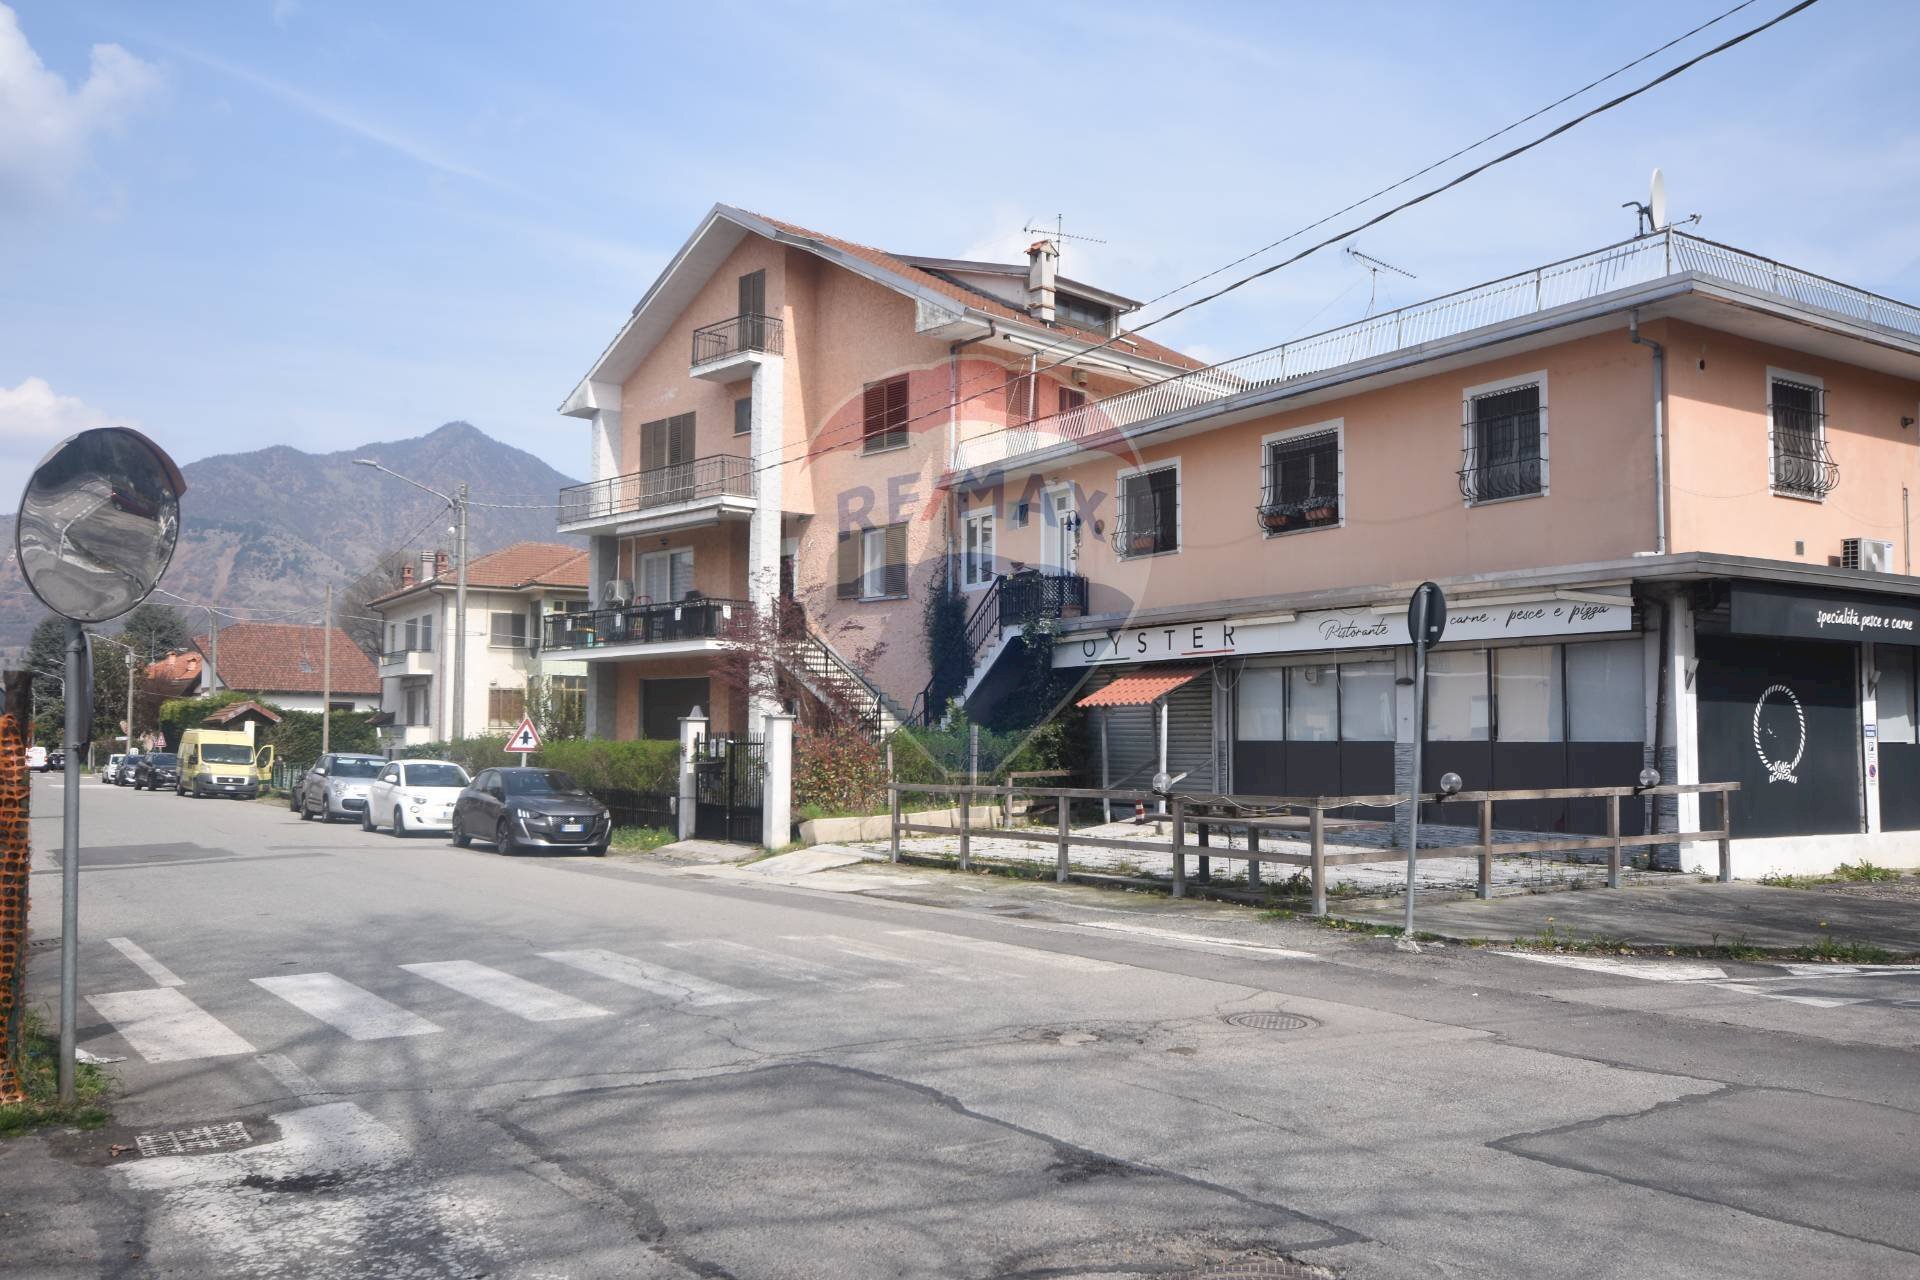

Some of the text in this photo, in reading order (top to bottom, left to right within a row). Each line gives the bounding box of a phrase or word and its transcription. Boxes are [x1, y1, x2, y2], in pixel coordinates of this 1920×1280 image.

[1319, 617, 1389, 640] Ristorante
[1505, 608, 1545, 628] pesce
[1553, 608, 1564, 617] e
[1568, 603, 1610, 624] pizza
[1860, 616, 1882, 631] pesce
[1883, 618, 1889, 627] e
[1891, 619, 1913, 630] carne
[1083, 624, 1235, 657] OYSTER
